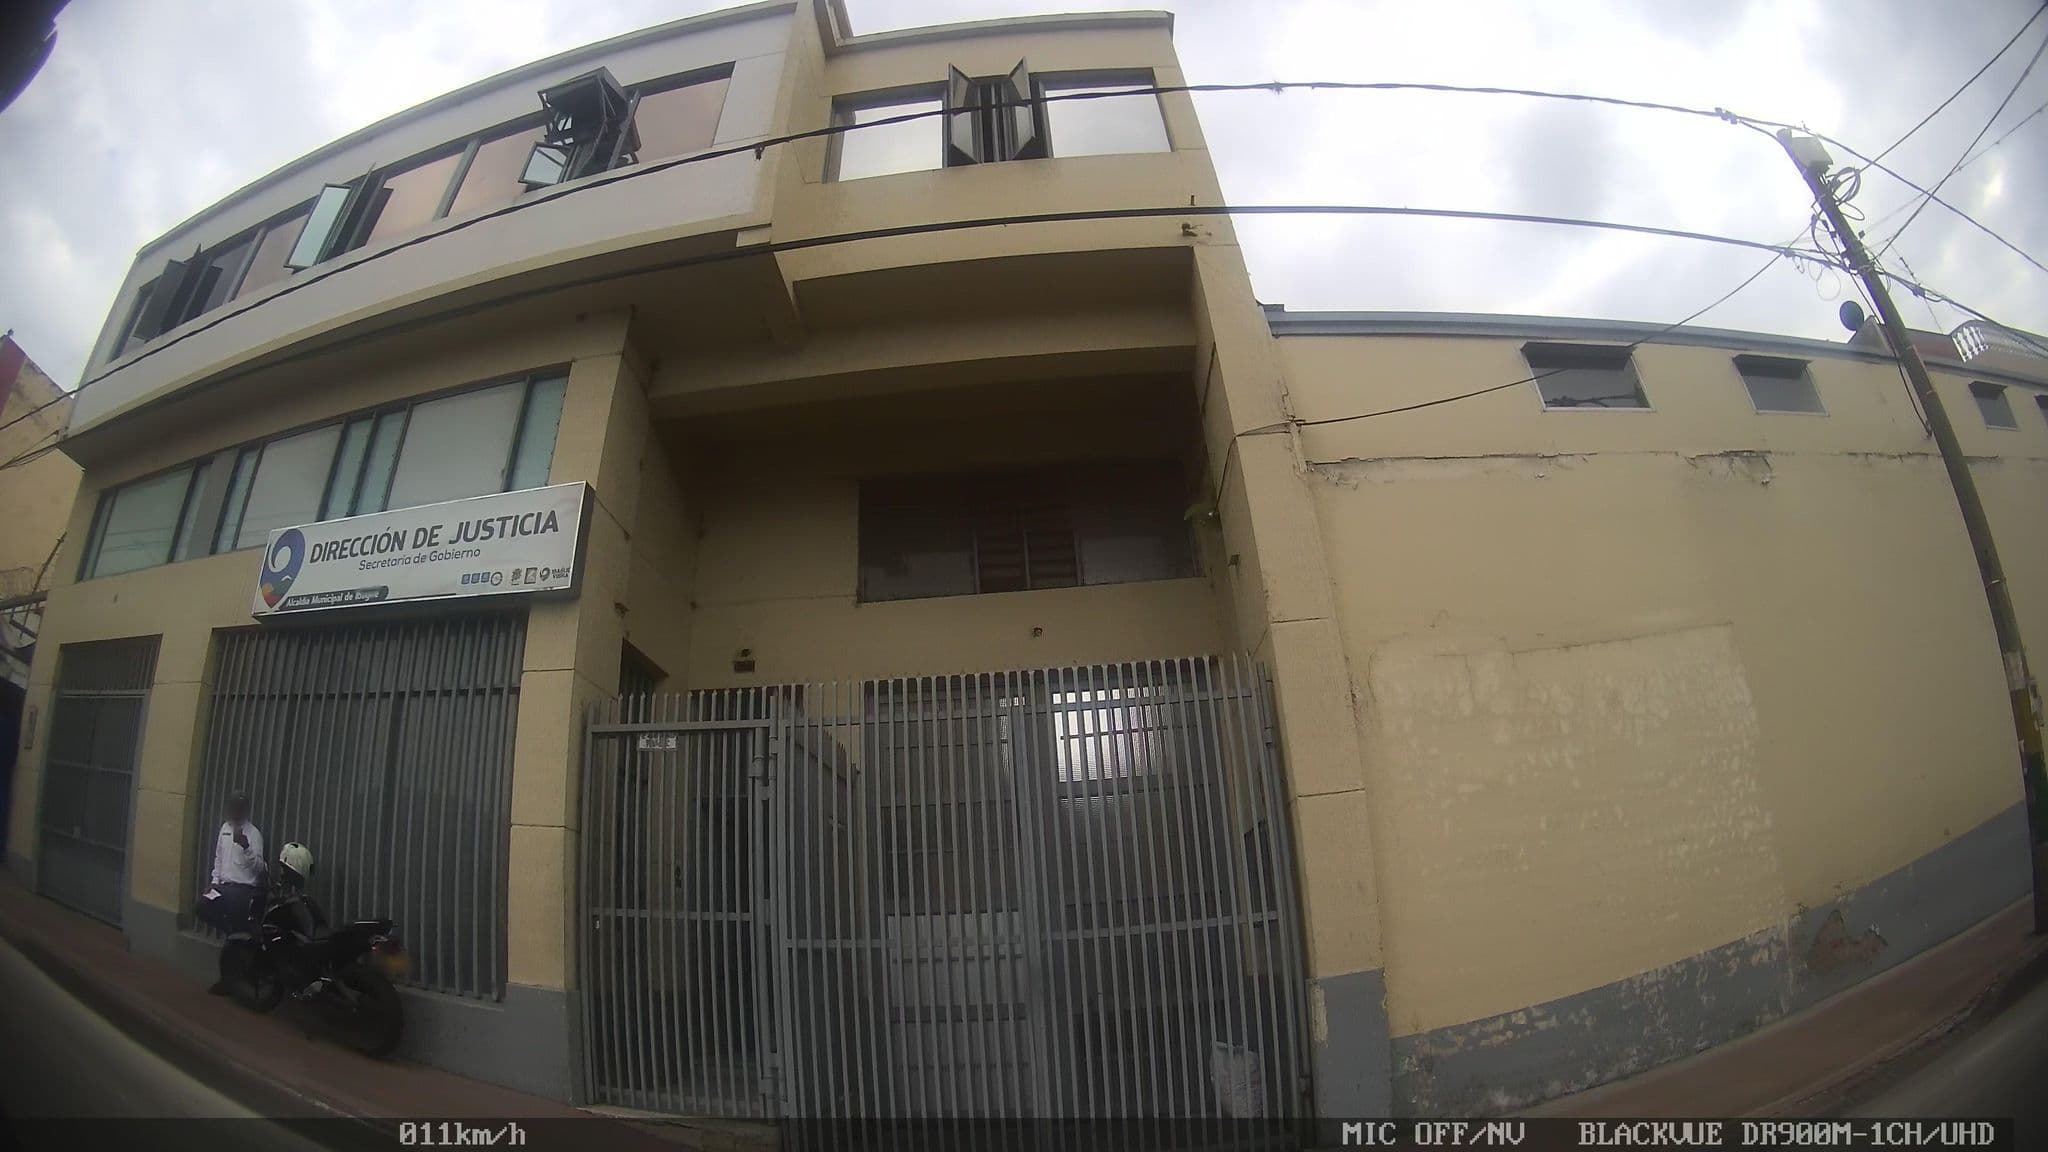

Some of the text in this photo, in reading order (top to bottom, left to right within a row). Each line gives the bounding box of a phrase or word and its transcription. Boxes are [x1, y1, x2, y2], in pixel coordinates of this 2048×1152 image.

[309, 510, 559, 564] DIRECCIÓN DE JUSTICIA
[413, 552, 427, 564] de
[429, 548, 481, 562] Gobierno
